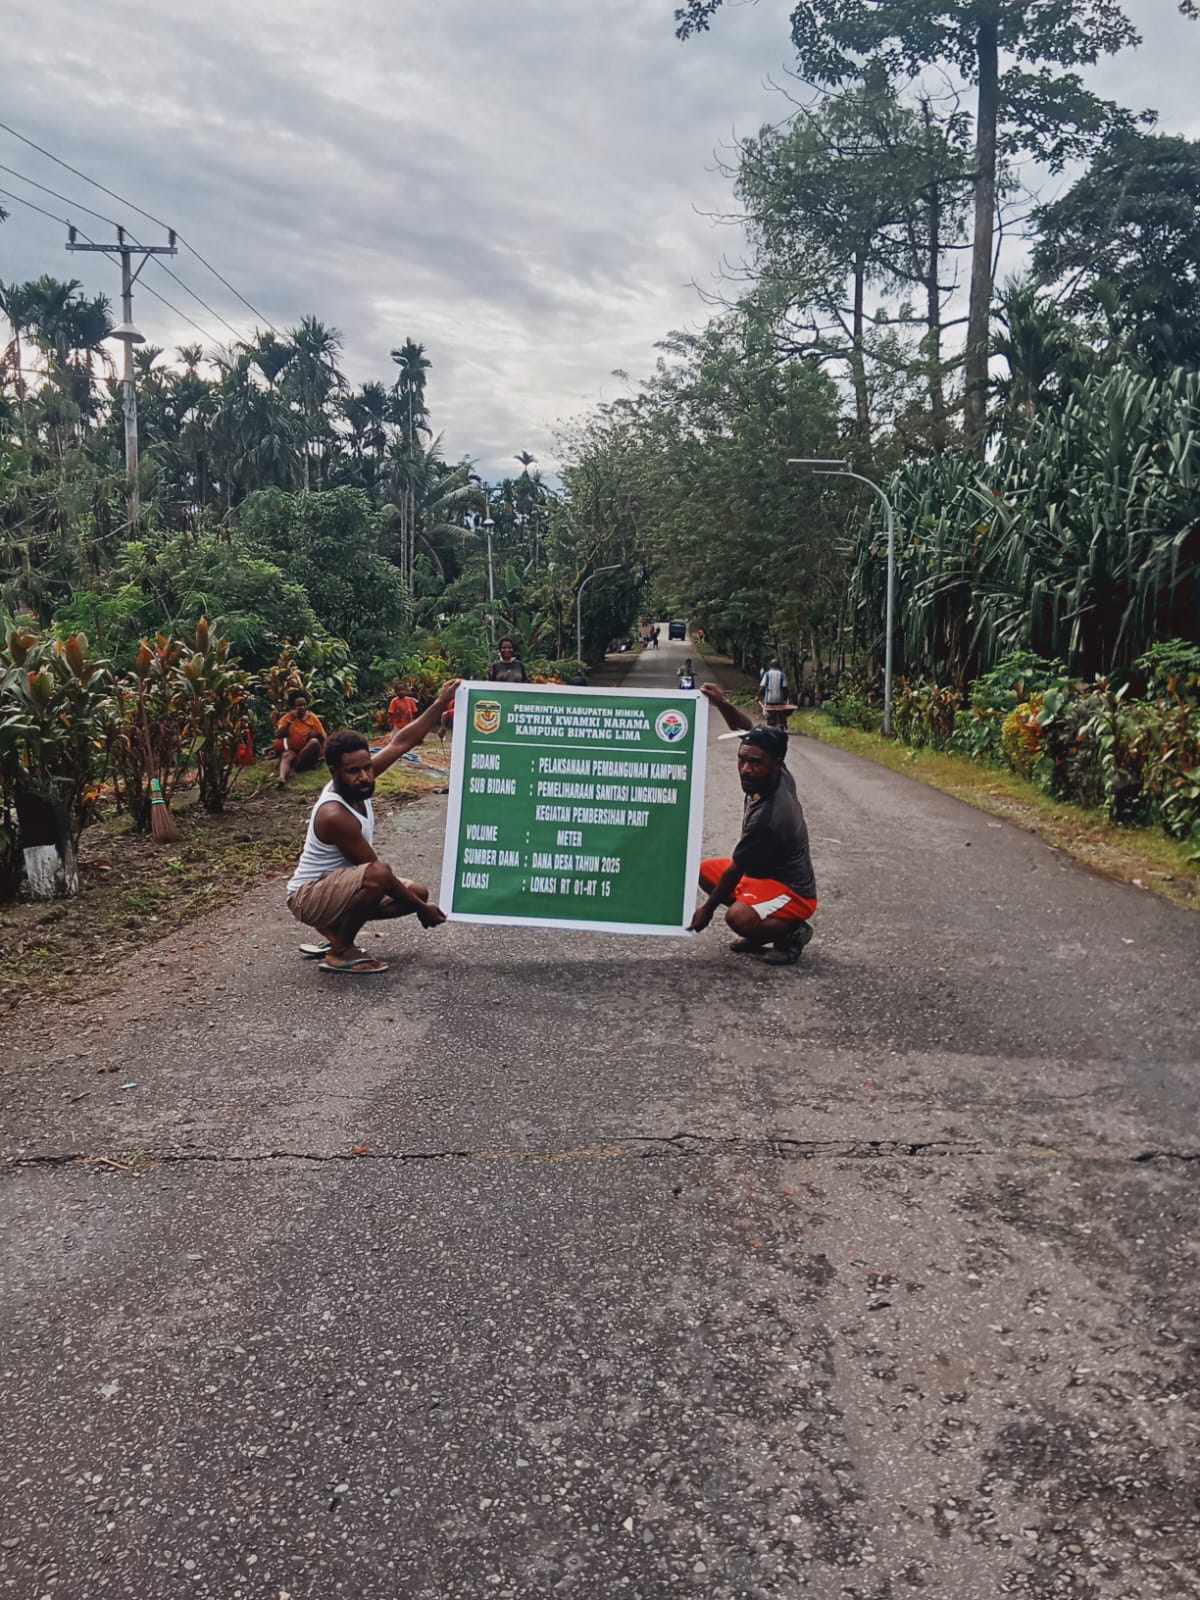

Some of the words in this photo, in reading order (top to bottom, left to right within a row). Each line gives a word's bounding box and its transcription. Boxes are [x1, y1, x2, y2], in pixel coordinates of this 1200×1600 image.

[507, 713, 552, 725] DISTRIK
[556, 715, 600, 728] KWAMKI
[604, 718, 650, 730] NARAMA
[514, 704, 564, 714] PEMERINTAH
[566, 706, 613, 717] KABUPATEN
[615, 709, 645, 718] MIMIKA
[515, 725, 565, 737] KAMPUNG
[568, 727, 612, 740] BINTANG
[615, 730, 641, 741] LIMA
[471, 753, 500, 771] BIDANG
[539, 757, 591, 776] PELAKSANAAN
[592, 760, 649, 779] PEMBANGUNAN
[650, 763, 688, 781] KAMPUNG
[469, 777, 485, 793] SUB
[487, 778, 517, 795] BIDANG
[537, 781, 594, 800] PEMELIHARAAN
[595, 784, 629, 802] SANITASI
[630, 786, 678, 804] LINGKUNGAN
[536, 804, 571, 822] KEGIATAN
[572, 807, 626, 826] PEMBERSIHAN
[627, 810, 650, 828] PARIT
[466, 824, 499, 842] VOLUME
[557, 830, 583, 848] METER
[463, 848, 497, 866] SUMBER
[498, 850, 520, 868] DANA
[532, 852, 552, 870] DANA
[554, 853, 574, 871] DESA
[575, 855, 600, 873] TAHUN
[601, 857, 621, 874] 2025
[461, 871, 490, 890] LOKASI
[530, 876, 557, 894] LOKASI
[560, 878, 571, 895] RT
[574, 879, 598, 896] 01-RT
[601, 881, 611, 897] 15
